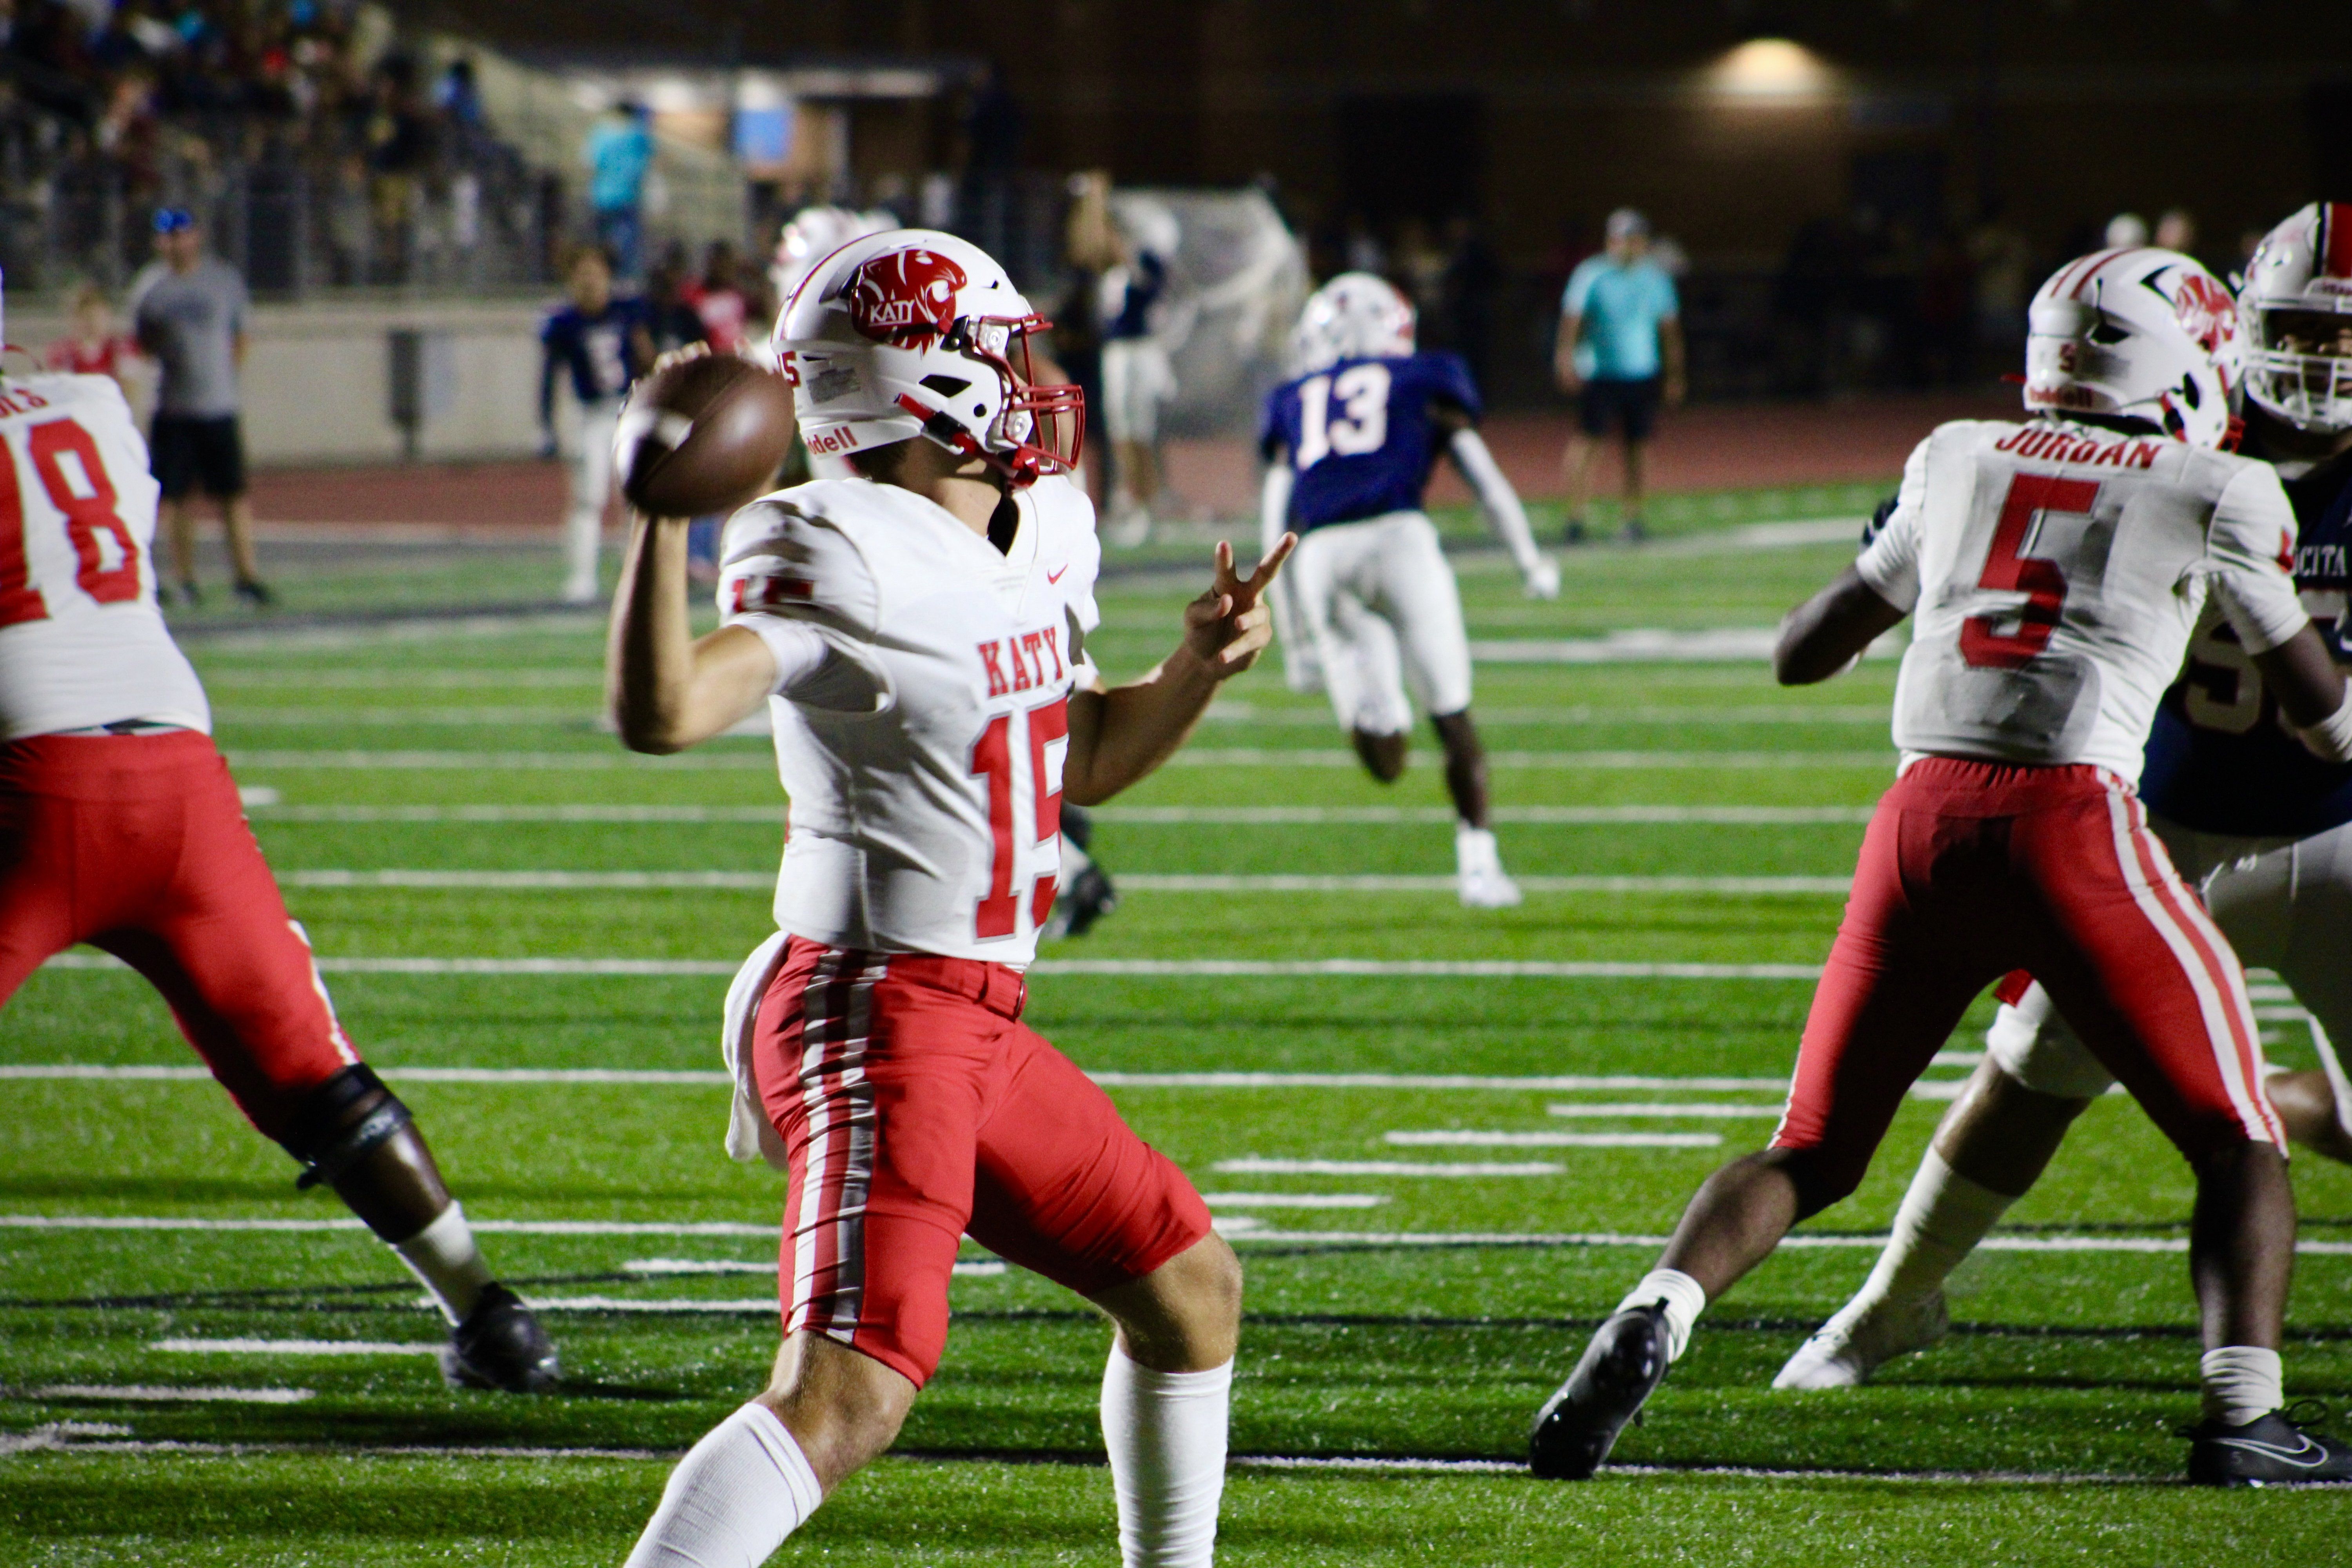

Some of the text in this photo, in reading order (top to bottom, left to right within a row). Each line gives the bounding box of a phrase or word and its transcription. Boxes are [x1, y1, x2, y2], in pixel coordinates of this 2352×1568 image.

[870, 299, 915, 325] KATY
[1297, 363, 1391, 471] 13
[1958, 473, 2101, 668] 5
[976, 624, 1063, 698] KATY
